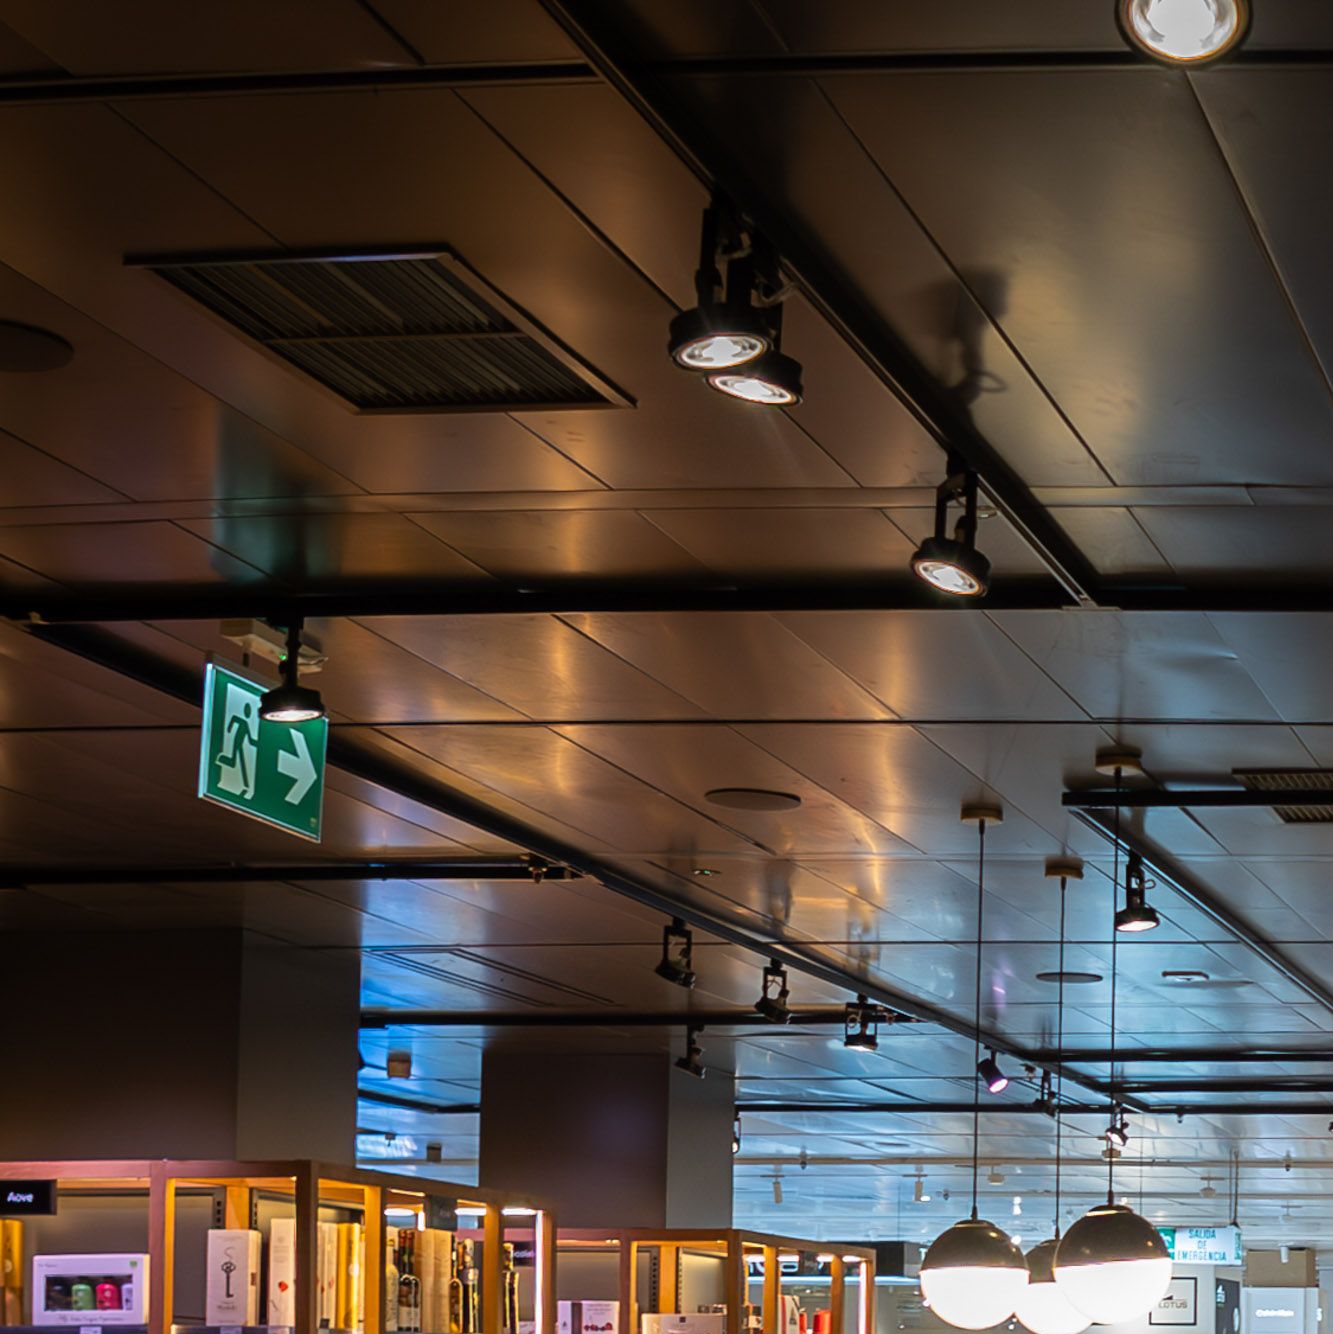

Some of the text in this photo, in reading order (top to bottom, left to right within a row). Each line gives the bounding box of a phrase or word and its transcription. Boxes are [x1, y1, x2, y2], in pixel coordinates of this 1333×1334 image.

[7, 1192, 34, 1203] Aove
[1188, 1228, 1217, 1239] SALIDA
[1196, 1240, 1207, 1249] DE
[1177, 1250, 1227, 1261] EMERGENCIA
[1158, 1301, 1188, 1309] LOTUS
